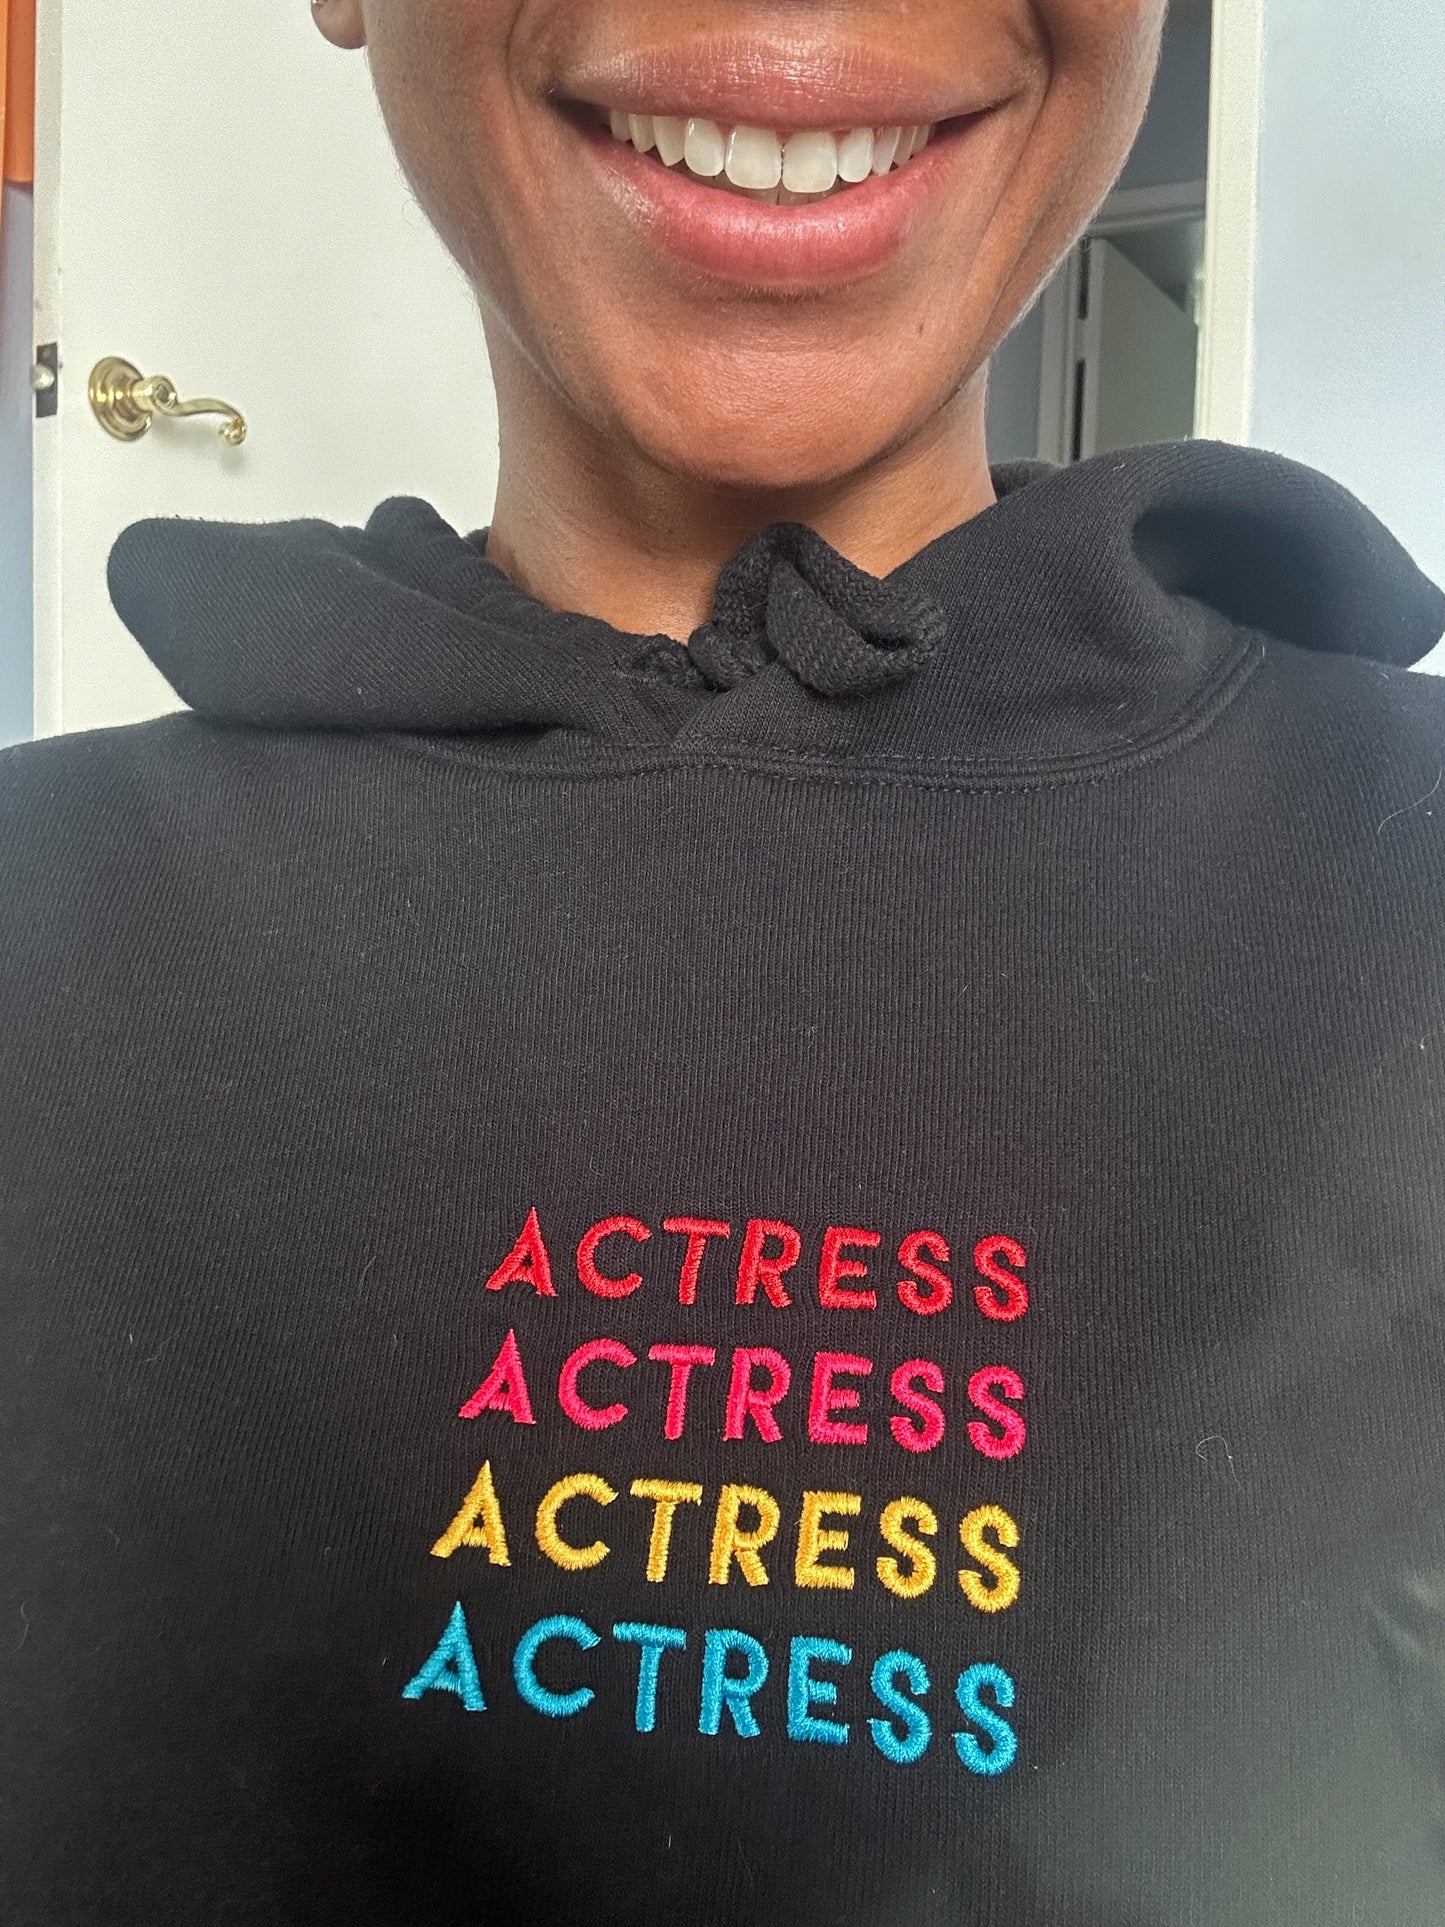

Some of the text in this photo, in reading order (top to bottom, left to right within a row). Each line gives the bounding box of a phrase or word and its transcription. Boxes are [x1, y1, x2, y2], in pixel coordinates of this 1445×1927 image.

[485, 1206, 1030, 1323] ACTRESS
[458, 1327, 1028, 1461] ACTRESS
[430, 1459, 1021, 1614] ACTRESS
[402, 1600, 1019, 1776] ACTRESS
